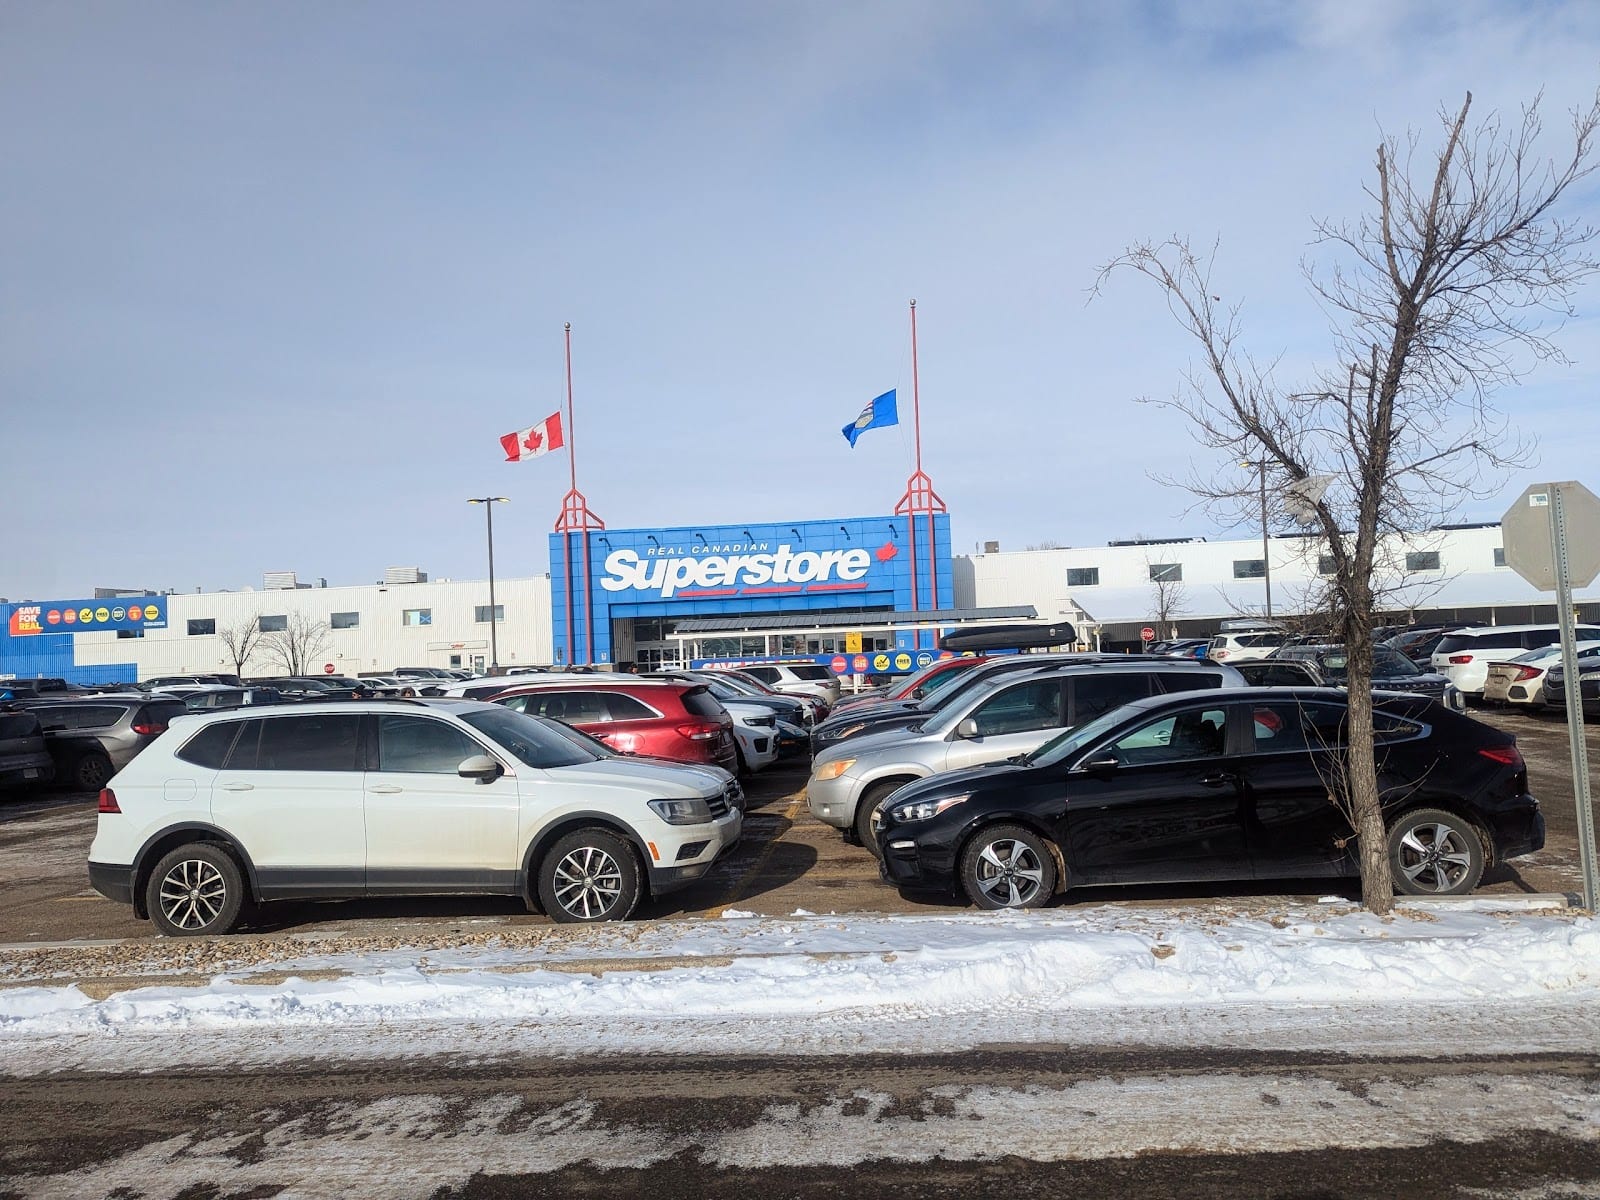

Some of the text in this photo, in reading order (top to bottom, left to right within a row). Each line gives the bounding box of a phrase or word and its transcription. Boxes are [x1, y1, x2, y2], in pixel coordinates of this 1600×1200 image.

[648, 543, 769, 556] REAL CANADIAN
[600, 544, 871, 598] Superstore
[18, 606, 41, 615] SAVE
[18, 614, 37, 623] FOR
